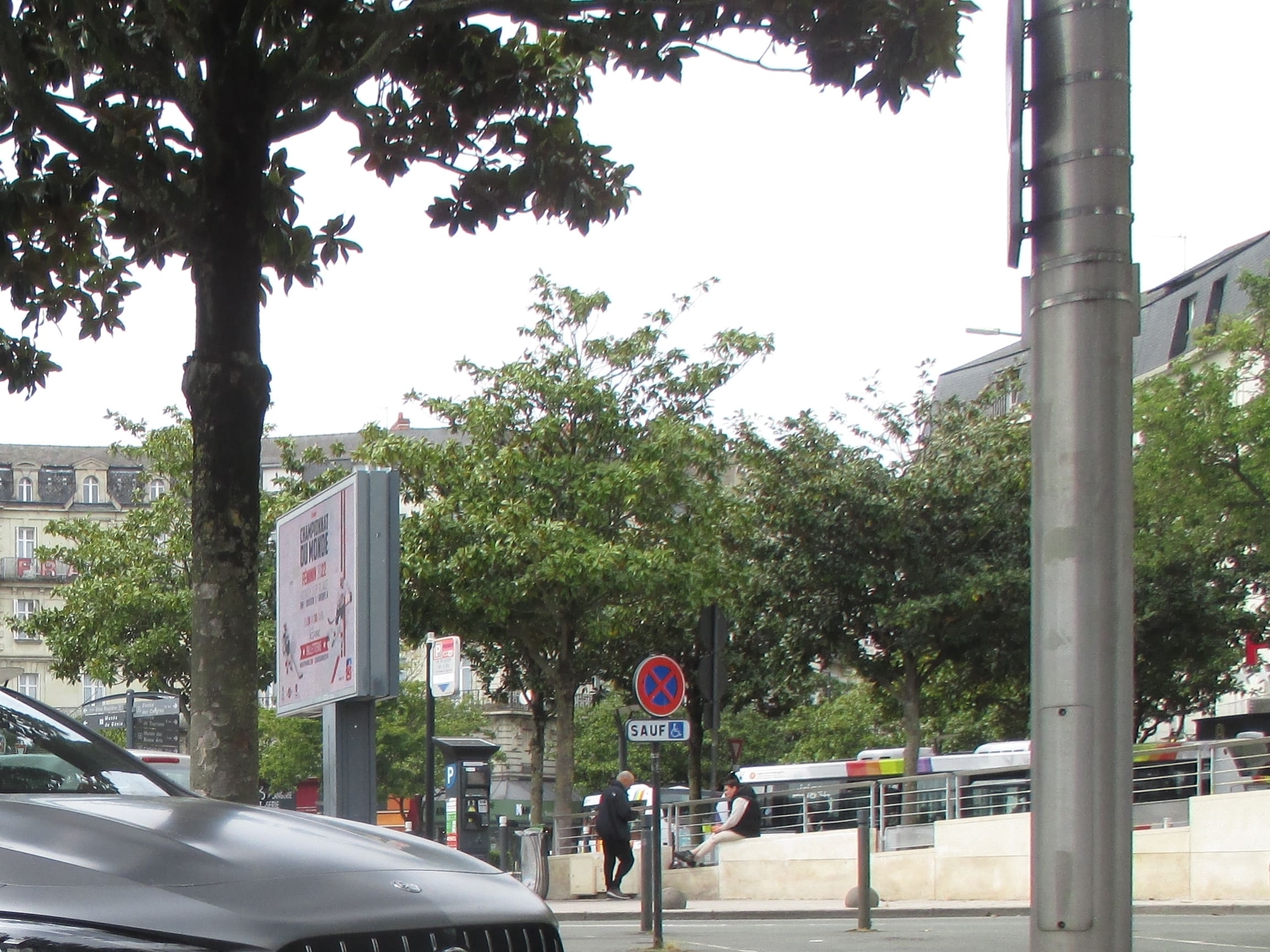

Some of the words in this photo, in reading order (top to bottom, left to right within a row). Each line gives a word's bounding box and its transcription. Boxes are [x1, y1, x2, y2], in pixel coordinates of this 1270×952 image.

[18, 557, 79, 577] FRA
[630, 723, 665, 738] SAUF
[447, 766, 454, 784] P
